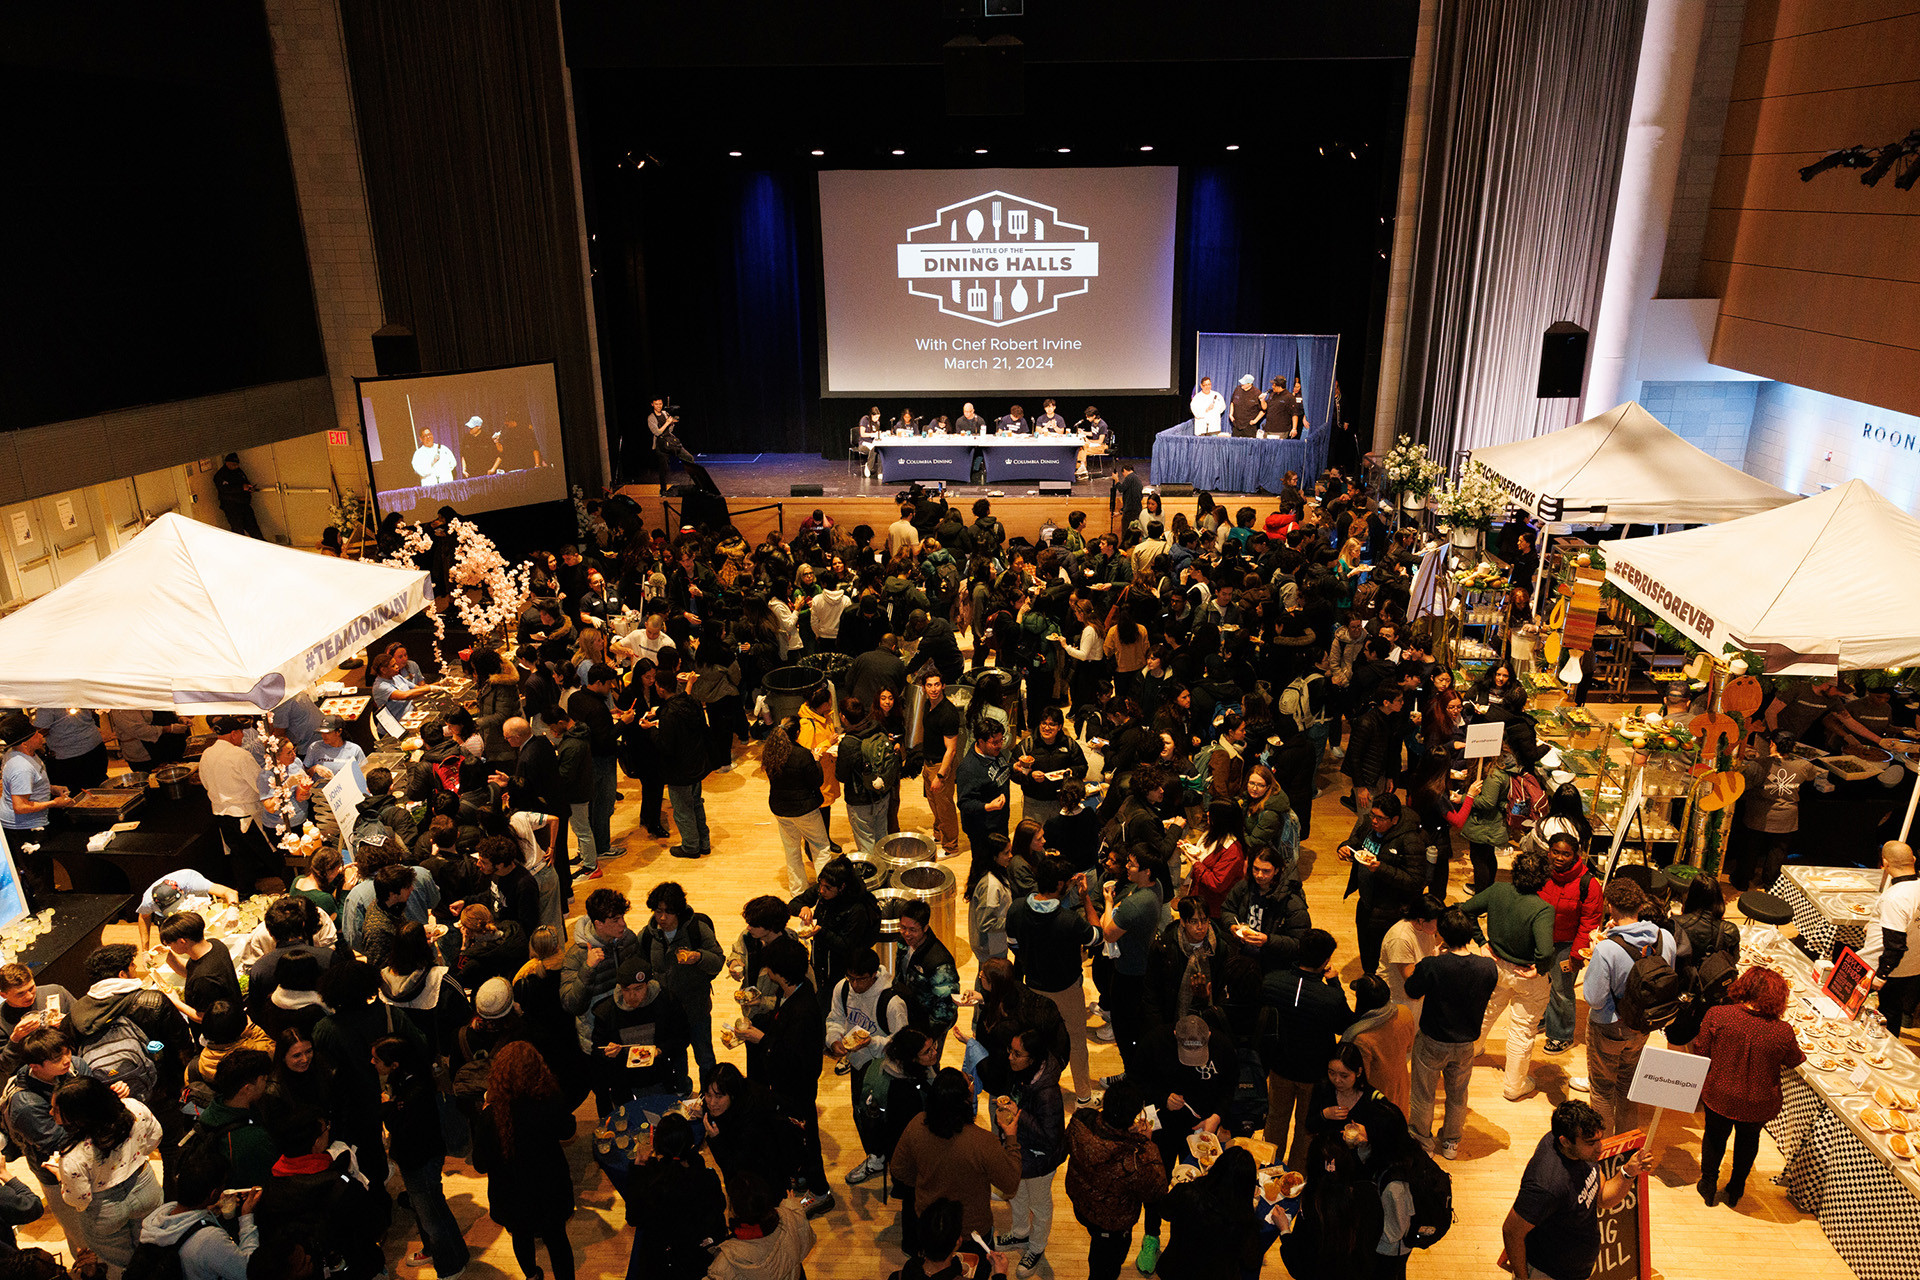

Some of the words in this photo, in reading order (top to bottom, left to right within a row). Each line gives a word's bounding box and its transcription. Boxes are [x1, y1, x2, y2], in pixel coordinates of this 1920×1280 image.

[924, 257, 999, 272] DINING
[1006, 256, 1073, 271] HALLS
[915, 338, 947, 350] With
[952, 337, 986, 350] Chef
[990, 338, 1038, 350] Robert
[1043, 337, 1082, 350] Irvine
[944, 357, 988, 370] March
[992, 357, 1012, 371] 21,
[1016, 356, 1054, 370] 2024
[328, 431, 347, 445] EXIT
[1863, 422, 1920, 453] ROON
[1613, 560, 1715, 640] #FERRISFOREVER
[305, 591, 408, 673] #TEAMJOHNJAY
[328, 784, 343, 802] JOHN
[1643, 1073, 1698, 1089] #BigSubsBigDill
[1604, 1153, 1625, 1180] IG
[1598, 1218, 1618, 1244] IG
[1597, 1242, 1631, 1273] ILL
